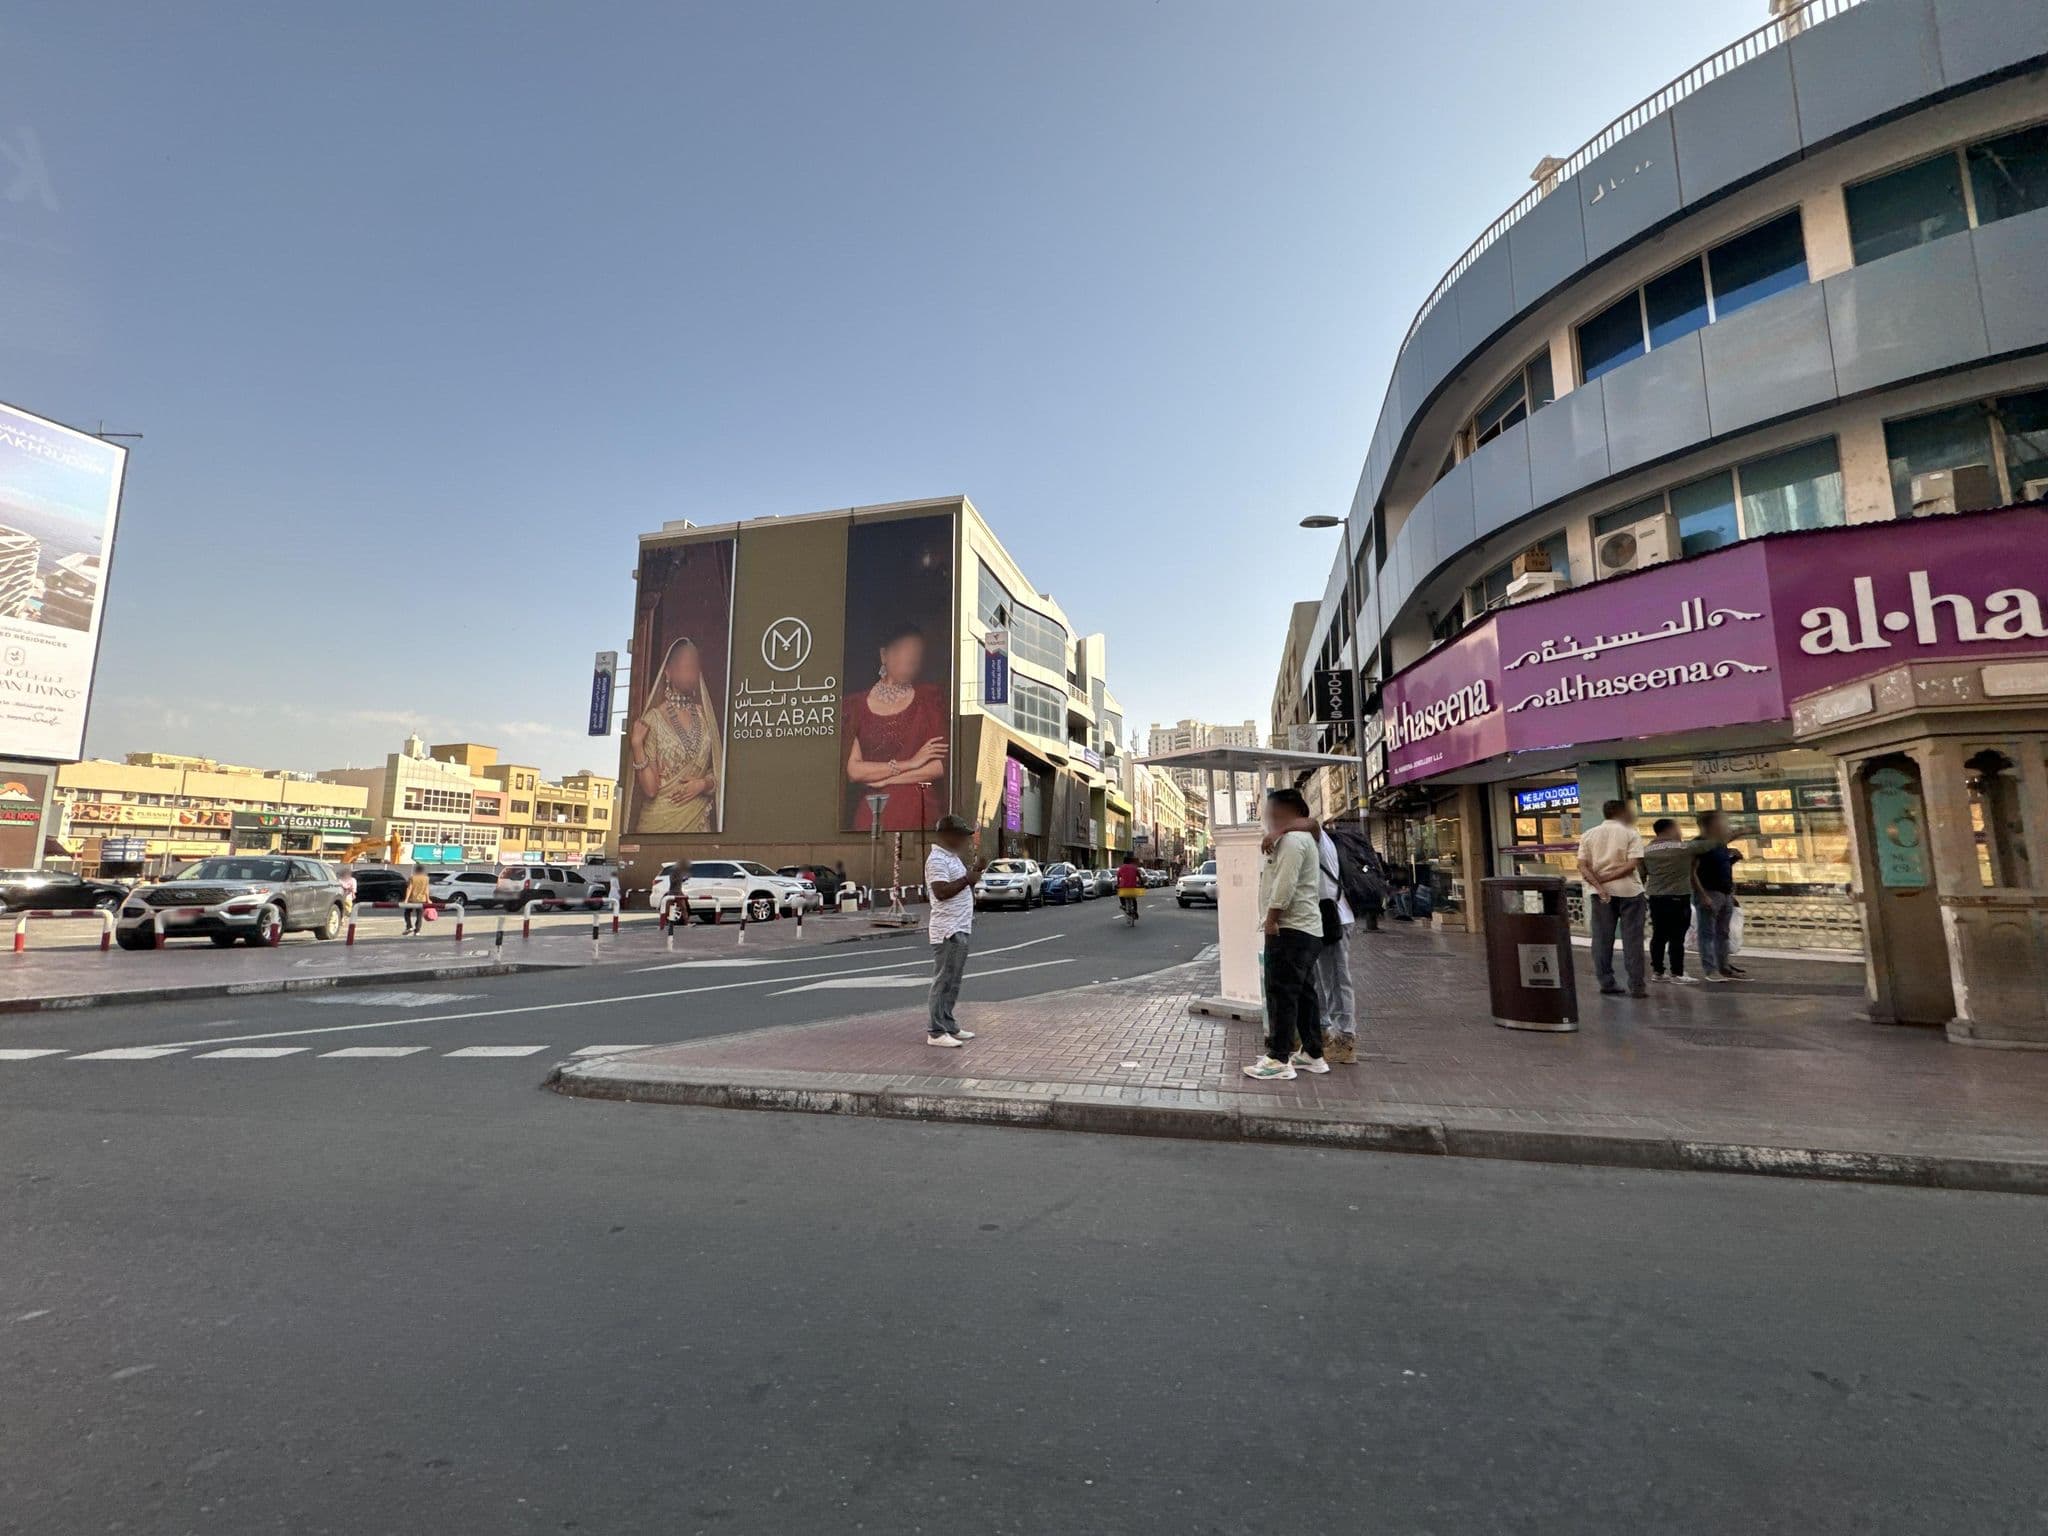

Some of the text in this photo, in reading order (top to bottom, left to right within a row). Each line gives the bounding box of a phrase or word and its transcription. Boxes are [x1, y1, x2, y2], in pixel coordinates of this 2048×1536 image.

[1542, 597, 1704, 662] الحسينة
[1328, 672, 1343, 719] TODAYS
[733, 707, 835, 727] MALABAR
[733, 726, 835, 739] GOLD & DIAMONDS
[1545, 789, 1558, 799] OLD
[1559, 786, 1576, 796] GOLD
[280, 816, 351, 828] VEGANESHA
